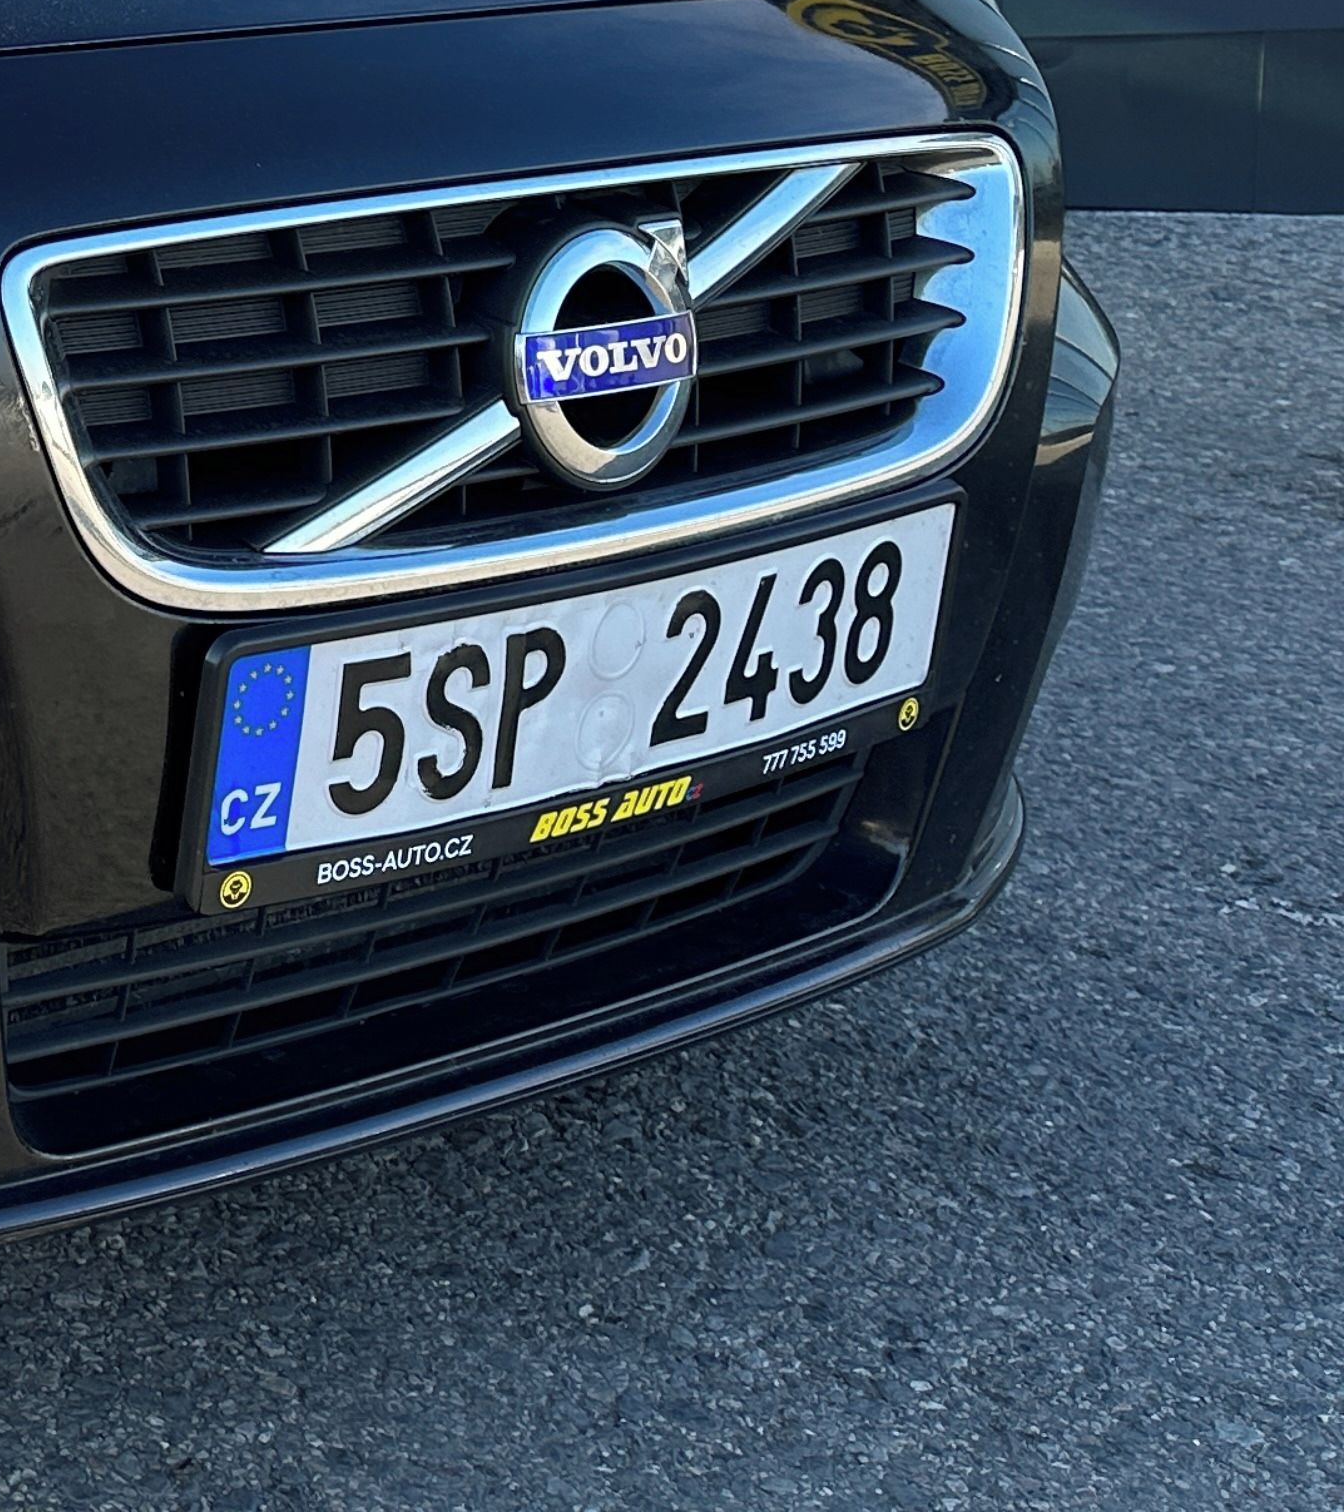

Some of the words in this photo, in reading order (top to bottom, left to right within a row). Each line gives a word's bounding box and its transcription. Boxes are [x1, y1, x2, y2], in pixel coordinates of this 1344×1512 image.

[537, 332, 687, 382] VOLVO
[328, 627, 566, 815] 5SP
[649, 540, 903, 748] 2438
[763, 749, 789, 775] 777
[790, 739, 817, 765] 755
[818, 729, 847, 755] 599
[220, 782, 282, 836] CZ
[529, 797, 611, 843] BOSS
[610, 775, 693, 823] AUTO
[317, 834, 474, 885] BOSS-AUTO.CZ
